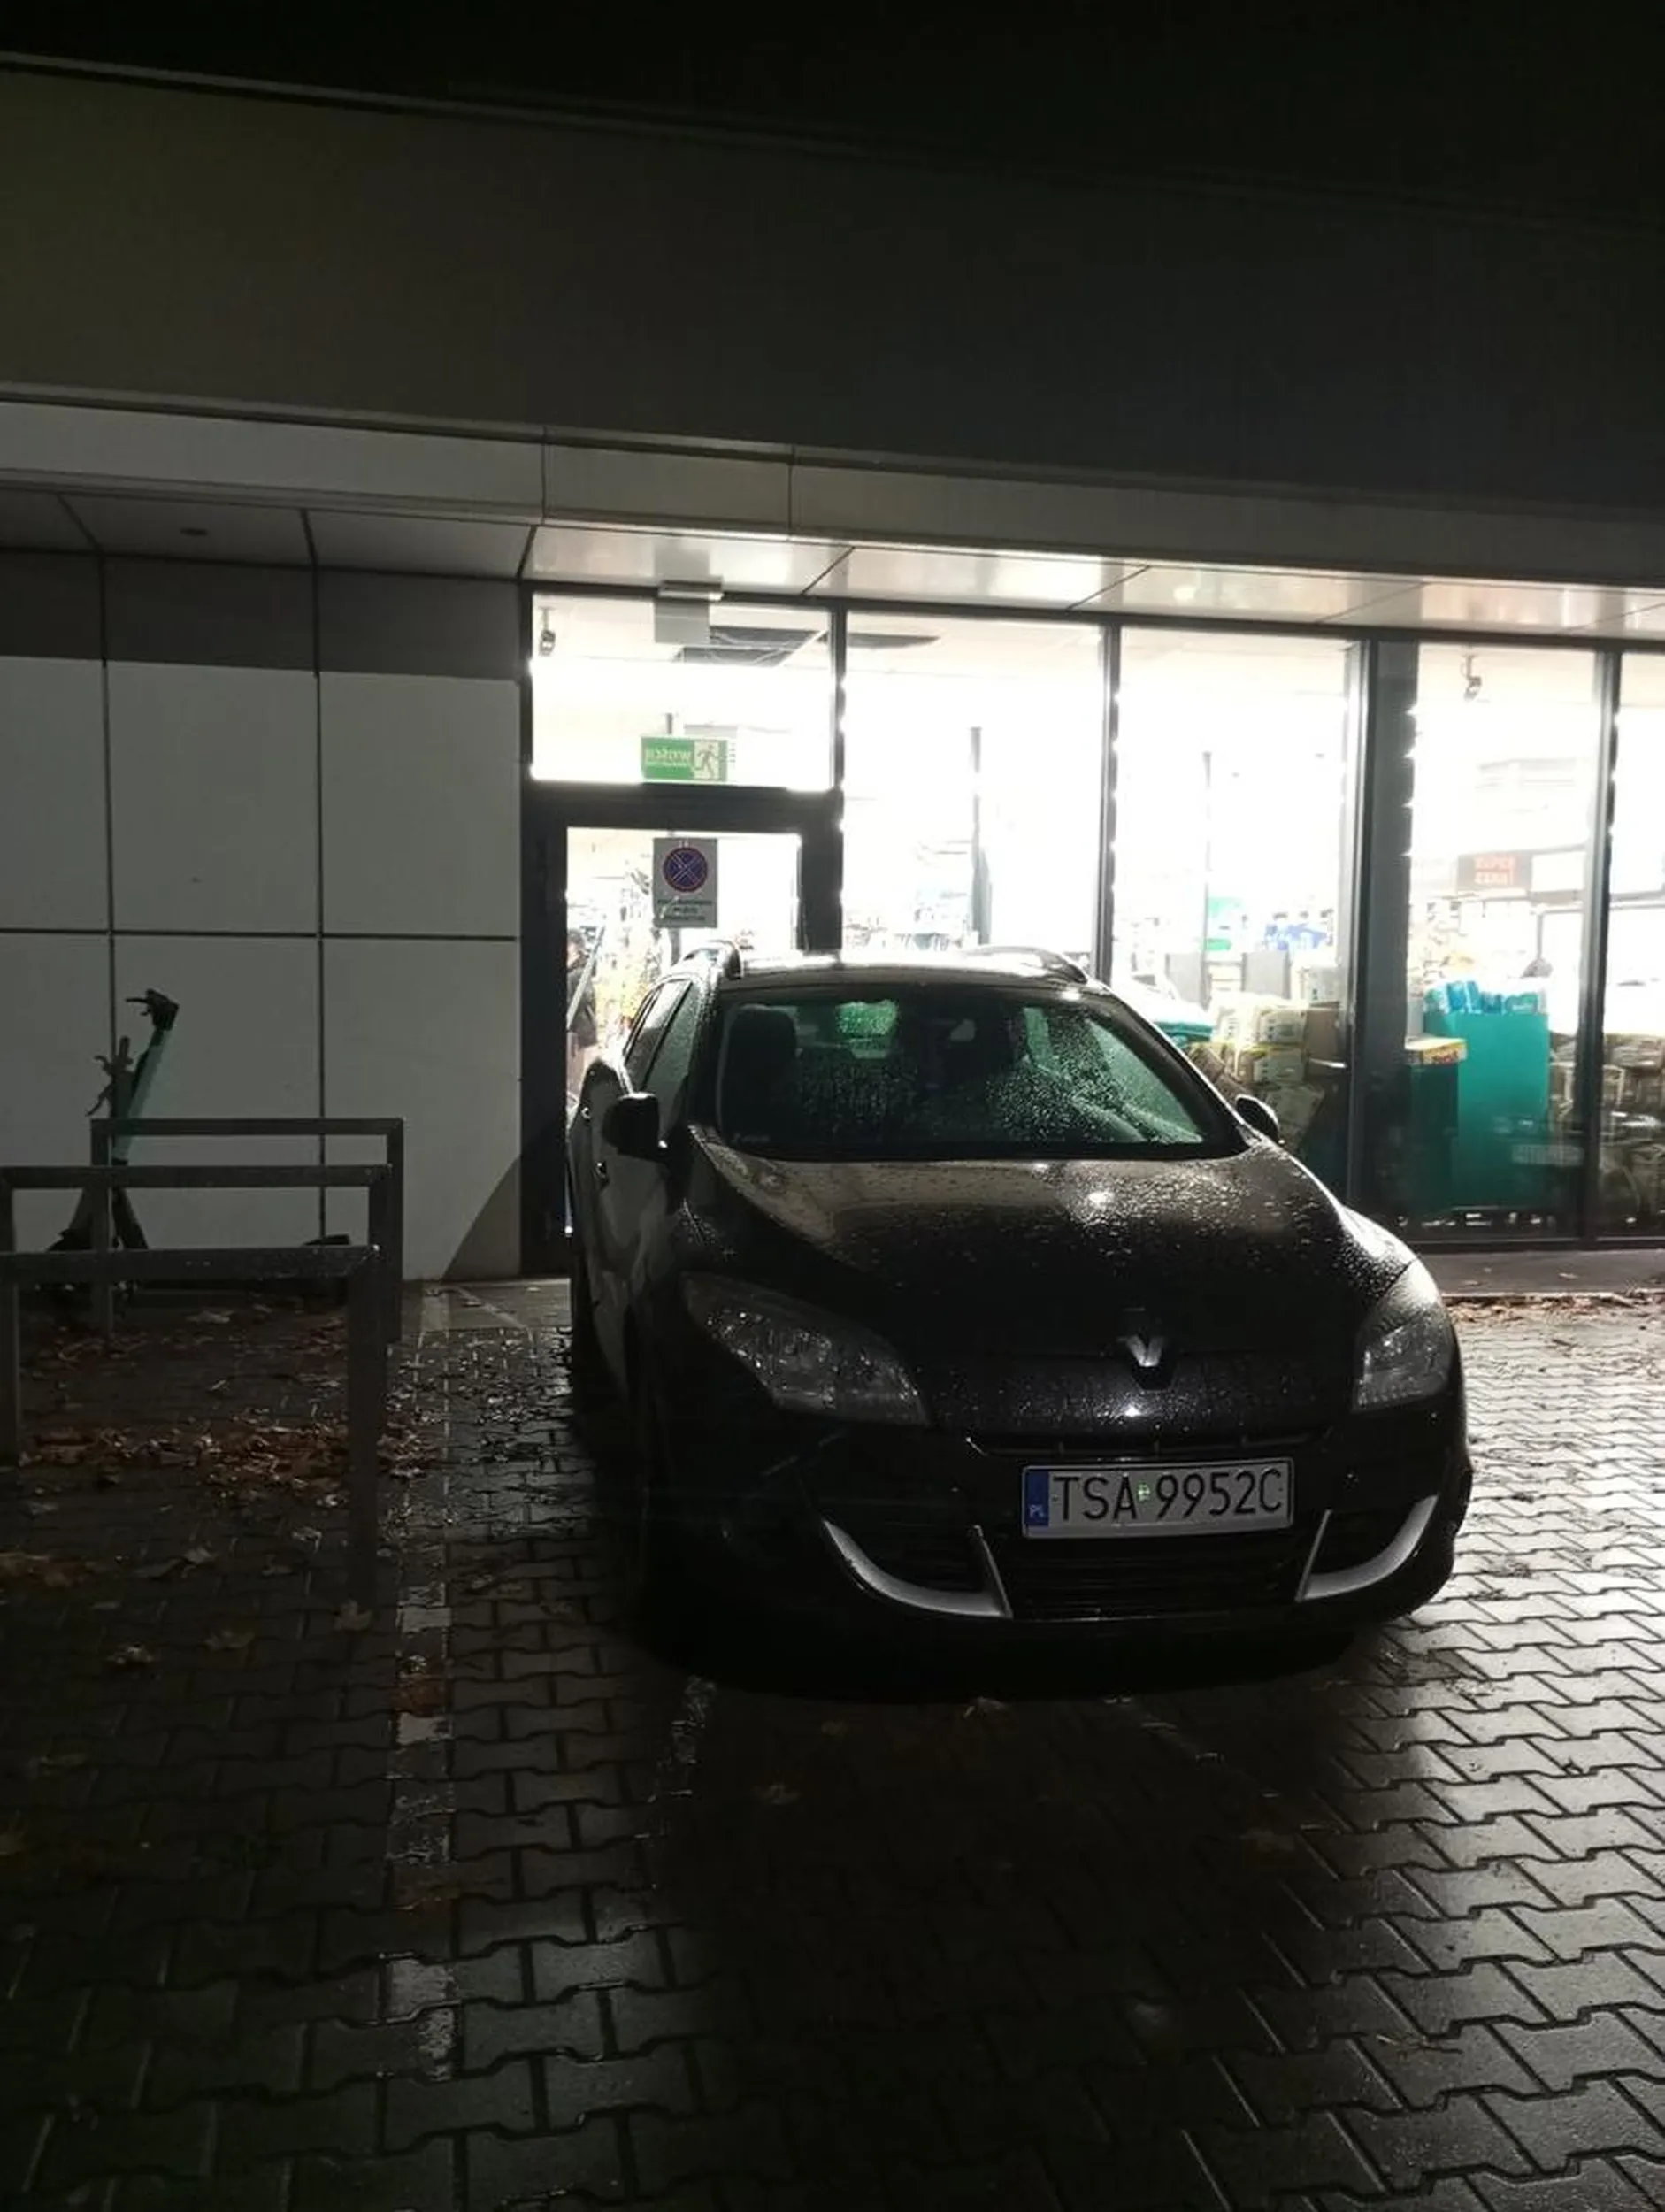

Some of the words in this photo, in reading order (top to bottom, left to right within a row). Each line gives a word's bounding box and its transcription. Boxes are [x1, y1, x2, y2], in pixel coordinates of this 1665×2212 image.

[1029, 1504, 1045, 1518] PL
[1053, 1475, 1138, 1521] TSA
[1156, 1468, 1282, 1520] 9952C
